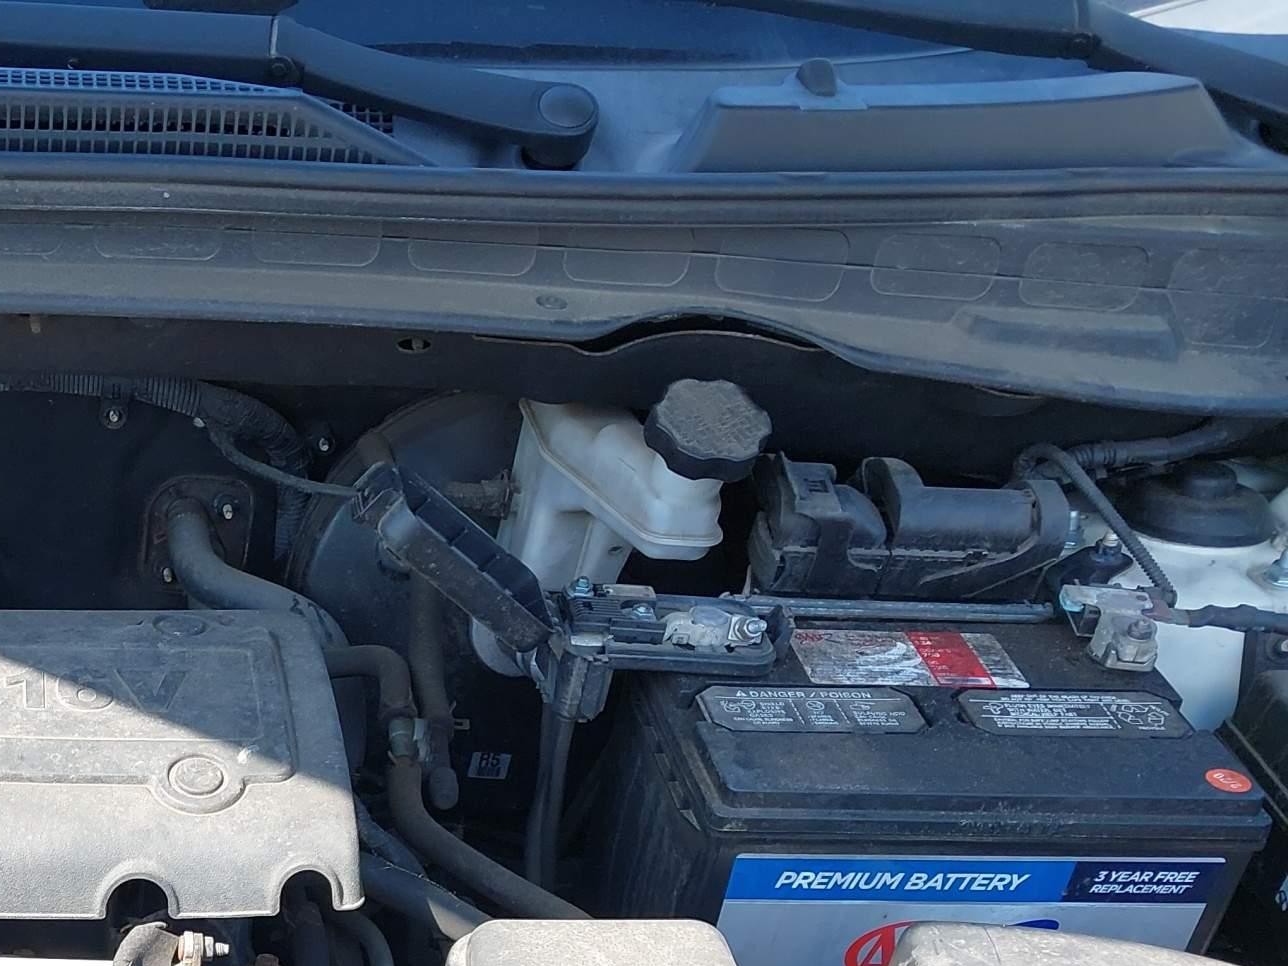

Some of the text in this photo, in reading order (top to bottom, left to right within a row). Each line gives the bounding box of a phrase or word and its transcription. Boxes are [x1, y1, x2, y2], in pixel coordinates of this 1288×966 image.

[4, 668, 188, 713] 16V
[749, 690, 806, 699] DANGER
[819, 691, 872, 700] POISON
[774, 871, 1032, 892] PREMIUM BATTERY
[1093, 870, 1201, 883] 3 YEAR FREE
[1089, 884, 1188, 894] REPLACEMENT
